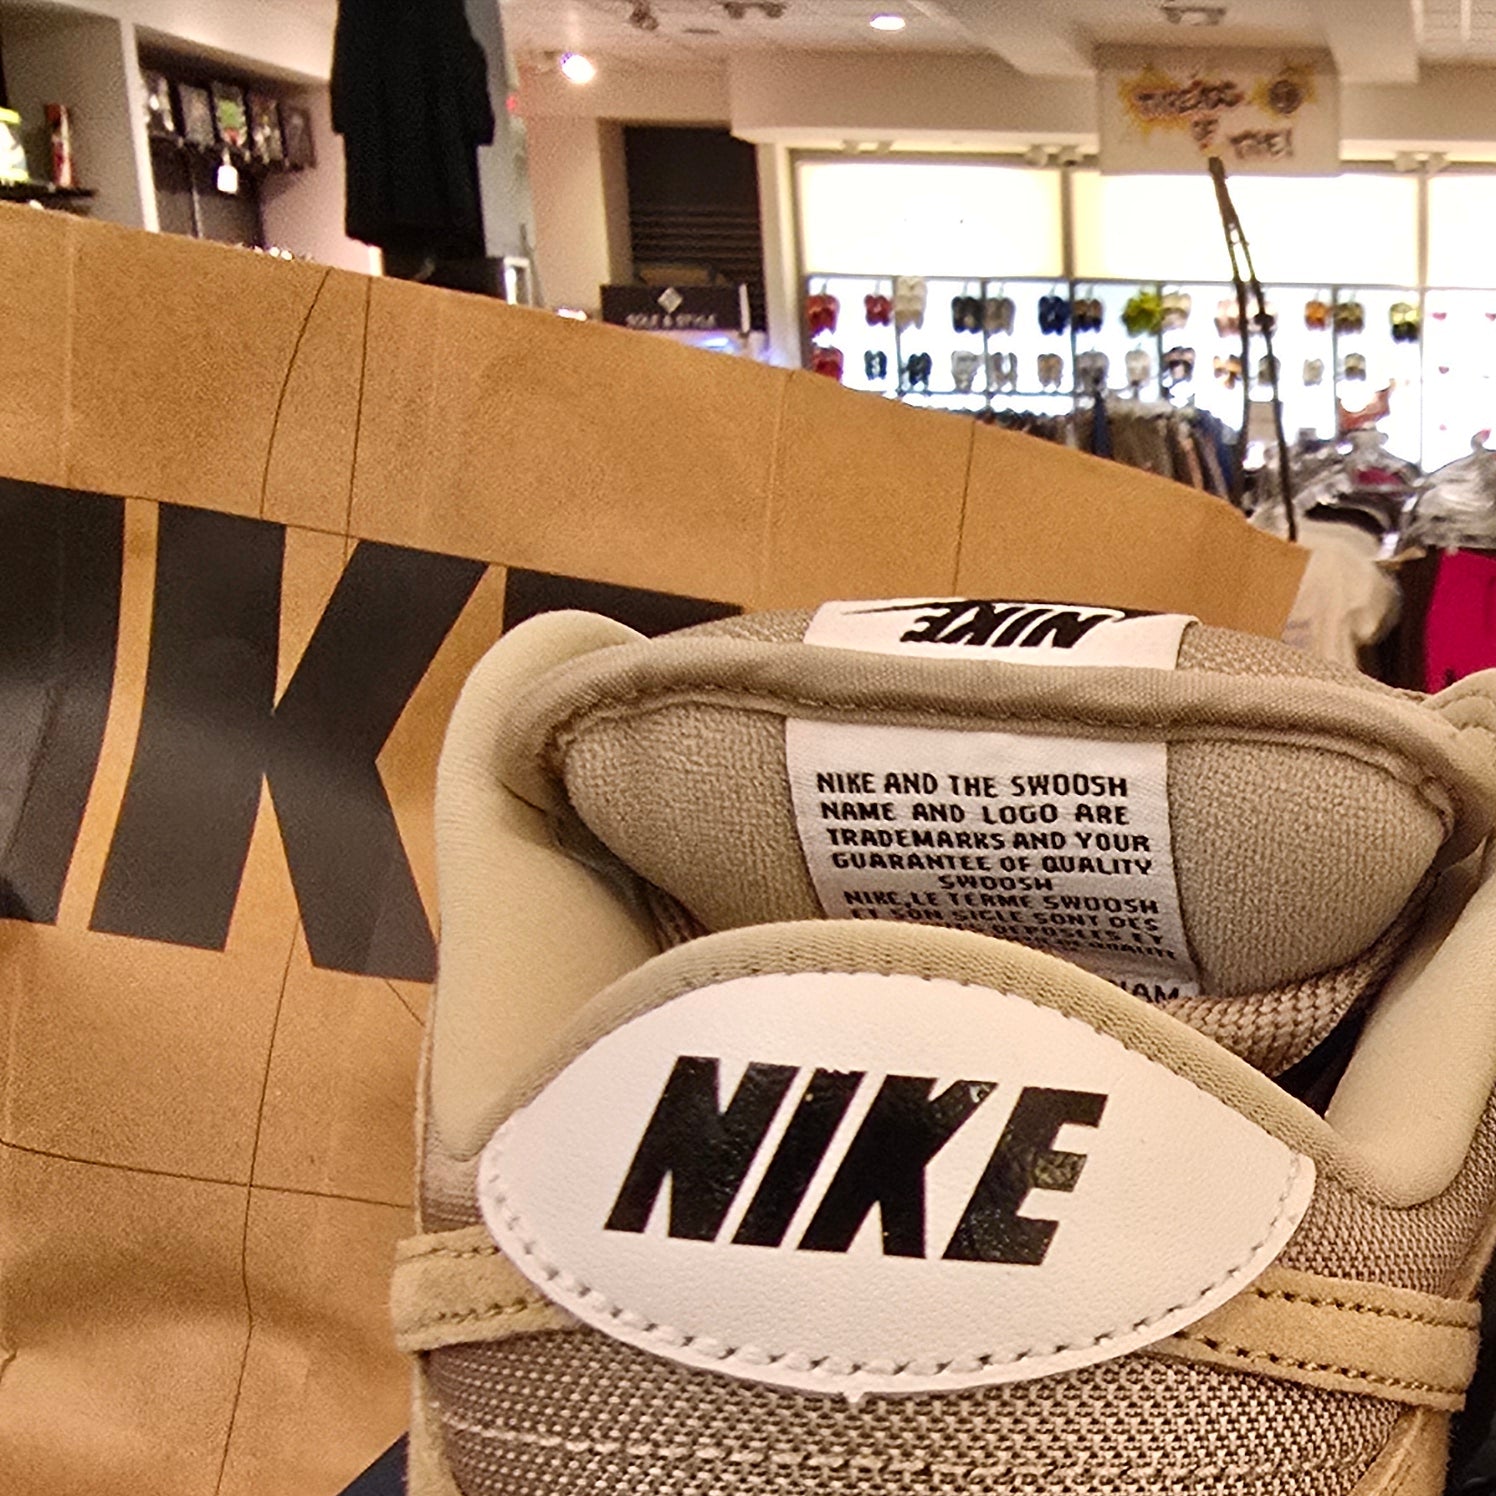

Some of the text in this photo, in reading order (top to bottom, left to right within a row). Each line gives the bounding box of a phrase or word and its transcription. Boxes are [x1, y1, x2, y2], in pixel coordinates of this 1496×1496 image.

[900, 601, 1112, 649] NIKE
[816, 771, 1128, 798] NIKE AND THE SWOOSH
[821, 801, 1130, 825] NAME AND LOGO ARE
[826, 828, 1151, 852] TRADEMARKS AND YOUR
[832, 852, 1152, 875] GUARANTEE OF QUALITY
[938, 874, 1054, 892] SWOOSH
[948, 892, 1032, 908] TERME
[1043, 895, 1160, 915] SWOOSH
[603, 1056, 1109, 1266] NIKE
